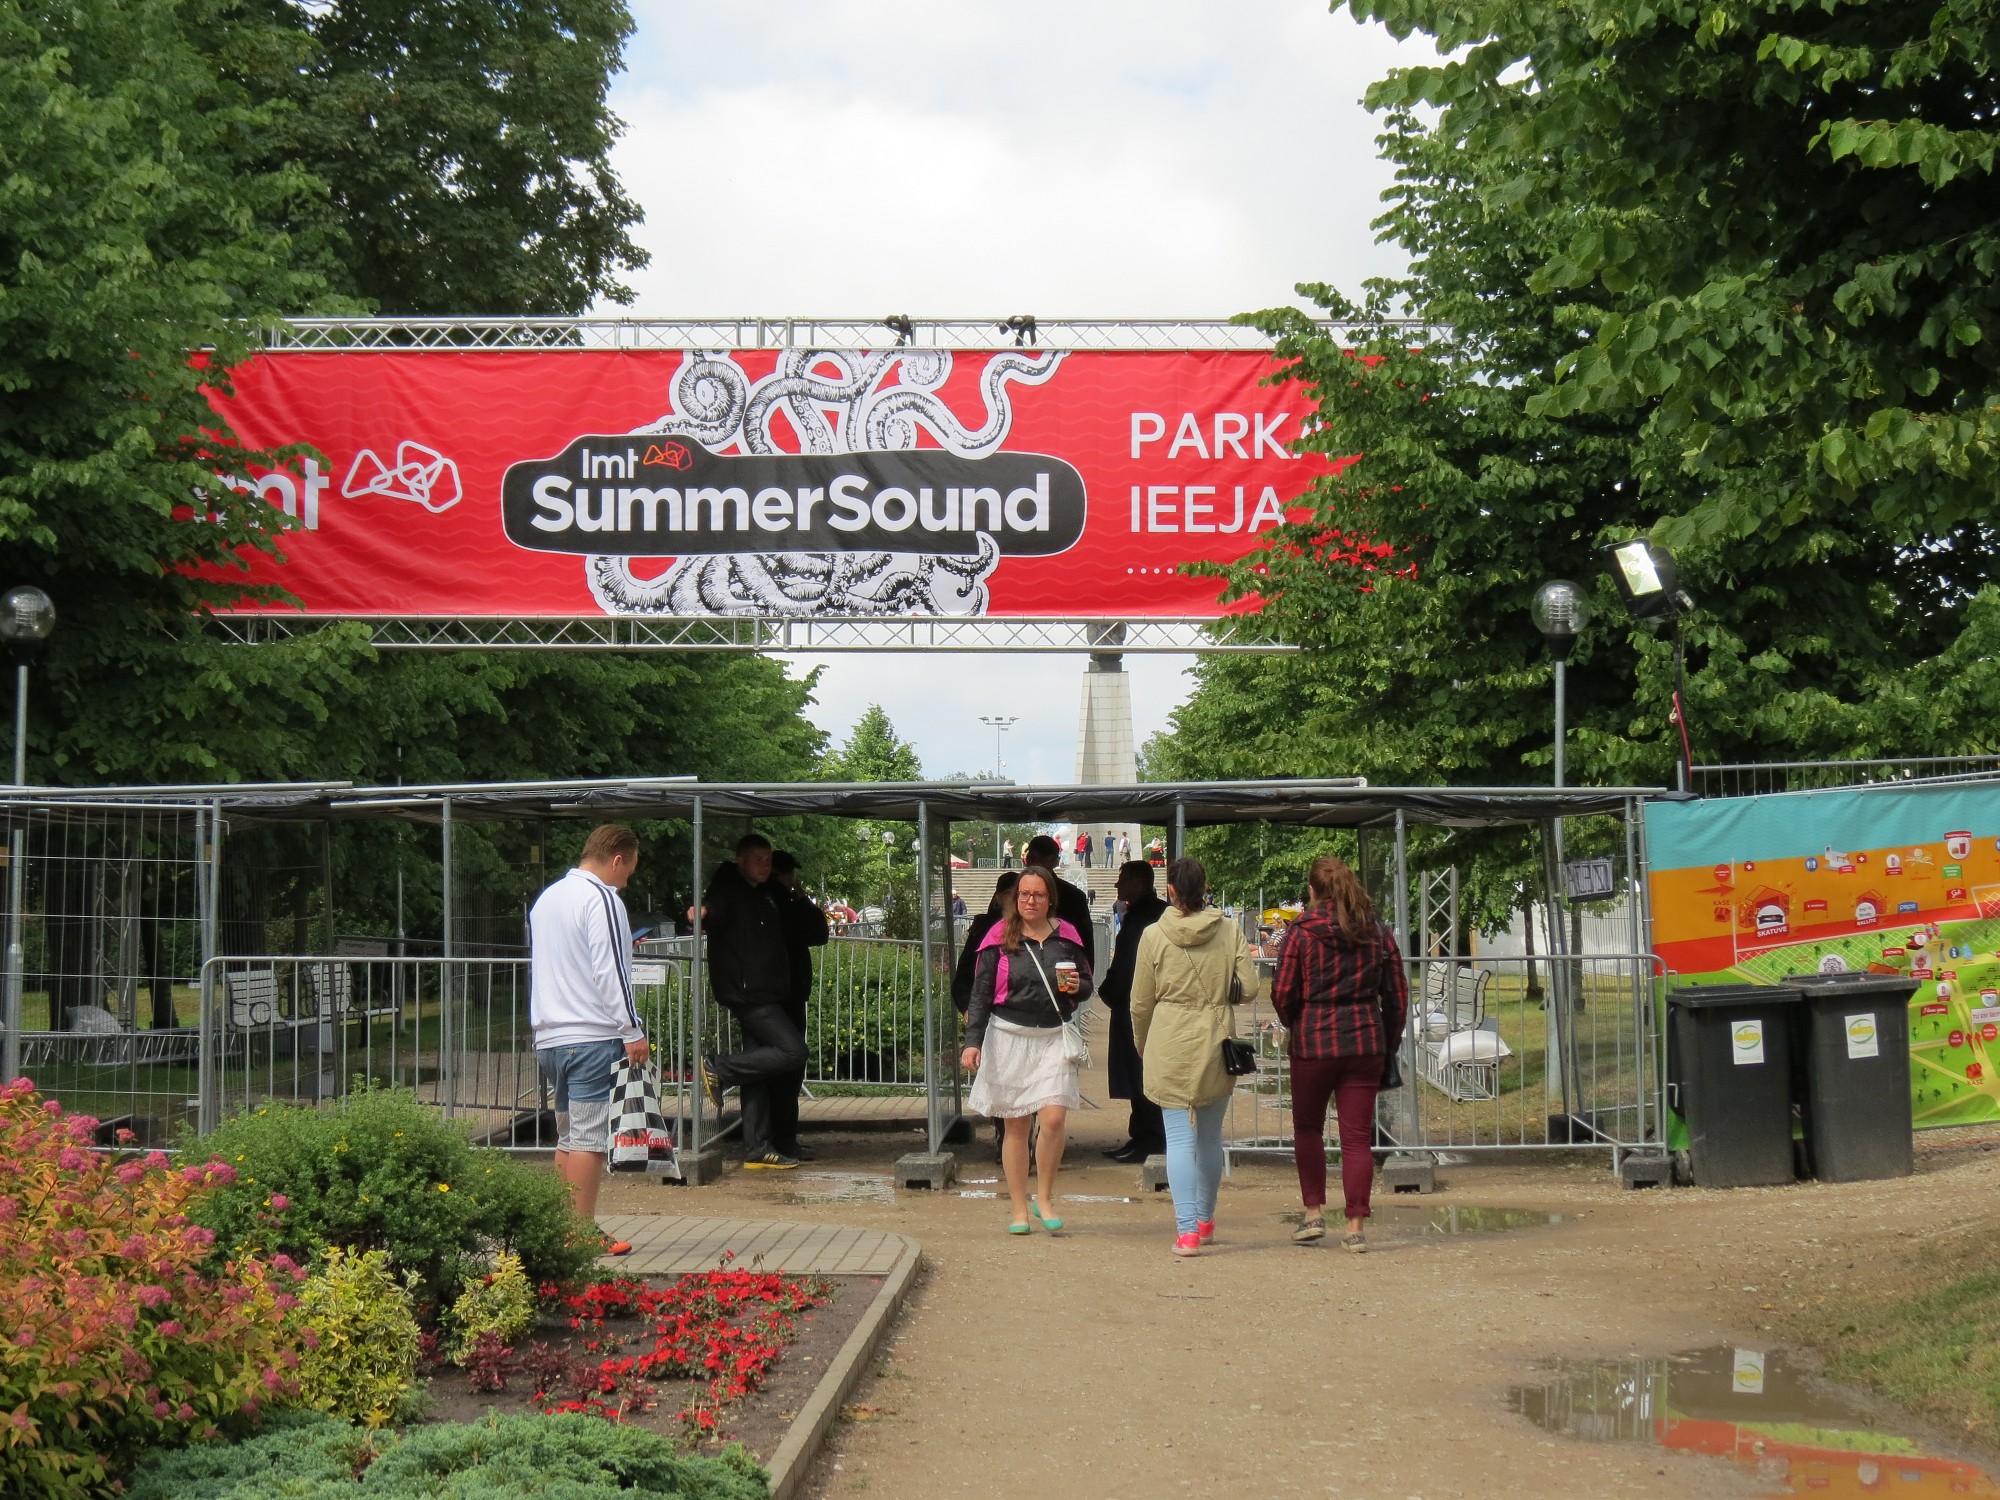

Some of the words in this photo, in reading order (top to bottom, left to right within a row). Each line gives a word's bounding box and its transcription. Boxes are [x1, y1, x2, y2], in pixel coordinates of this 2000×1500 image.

[581, 448, 638, 479] lmt
[530, 472, 1050, 532] SummerSound
[1130, 485, 1286, 533] IEEJA
